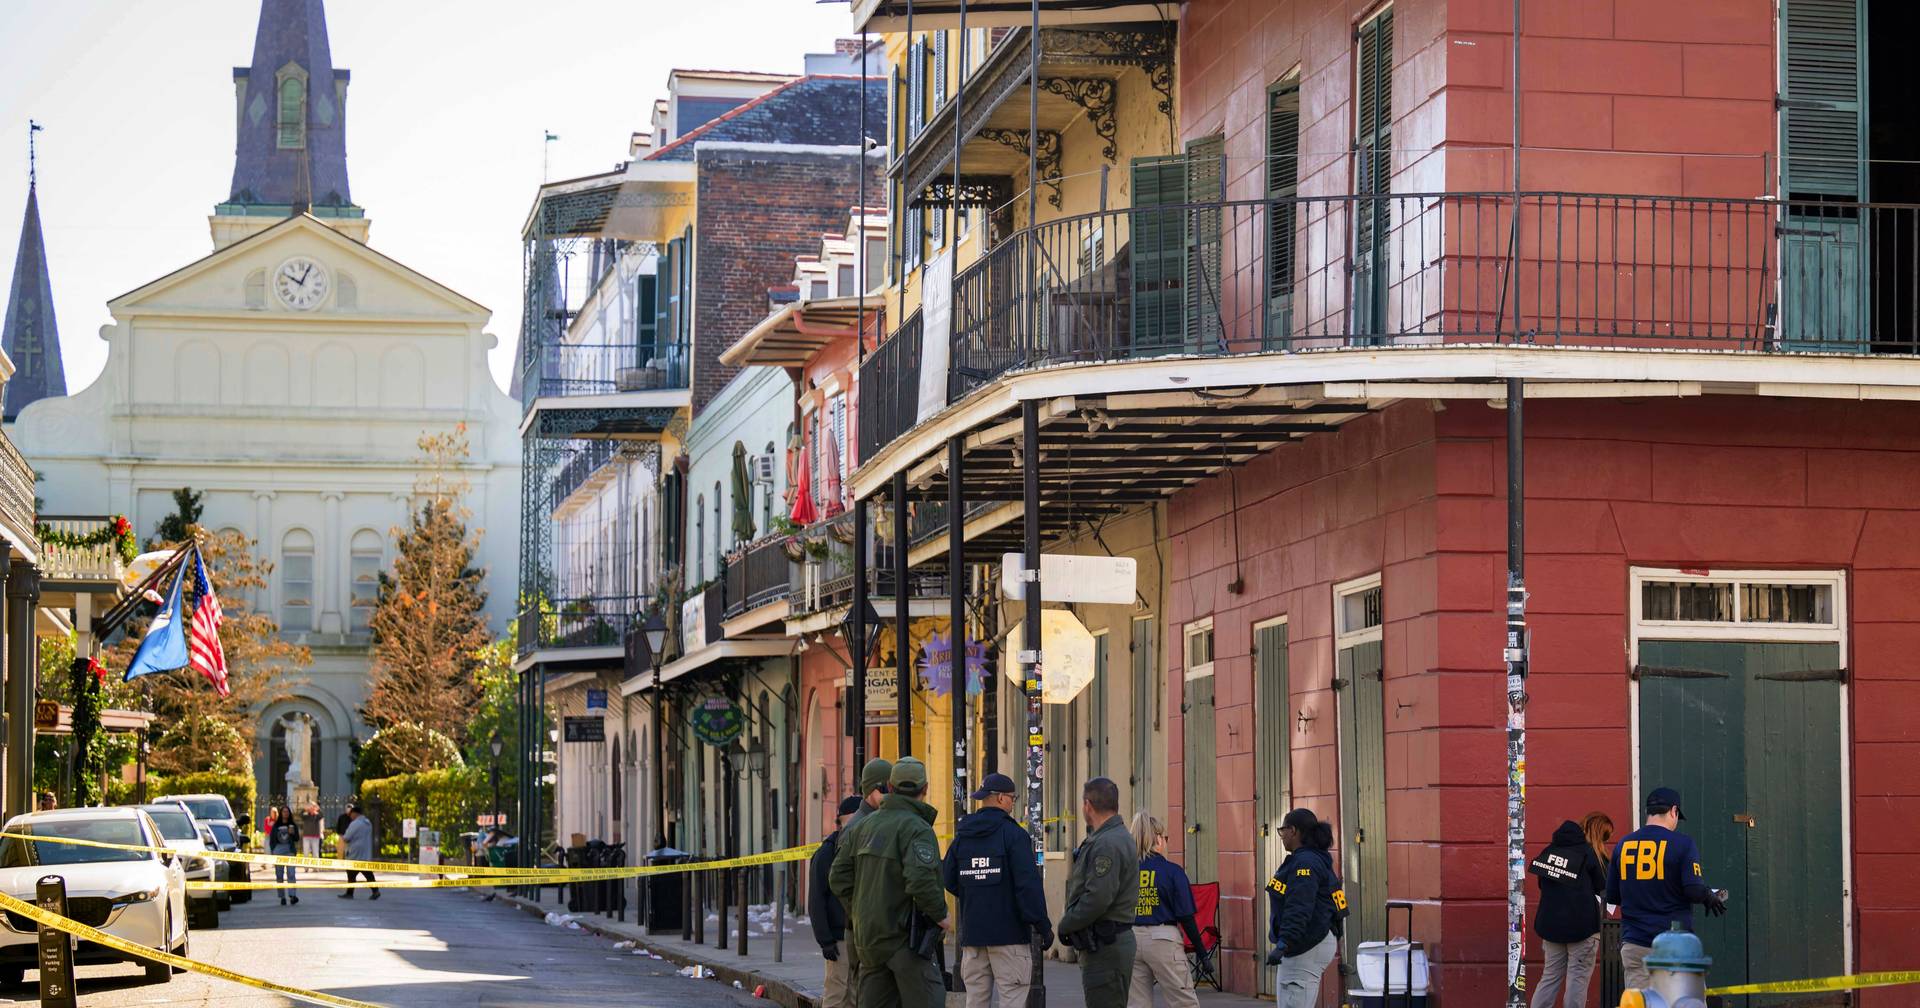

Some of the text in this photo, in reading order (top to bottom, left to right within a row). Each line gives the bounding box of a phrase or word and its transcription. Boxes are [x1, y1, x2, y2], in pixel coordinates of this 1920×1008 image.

[864, 678, 897, 687] IGAR
[972, 857, 989, 868] FBI
[1547, 854, 1568, 868] FBI
[1620, 840, 1667, 880] FBI
[1533, 860, 1578, 879] EVIDENCE RESPONSE
[1139, 870, 1156, 887] BI
[1268, 878, 1287, 894] FBI
[1138, 897, 1159, 906] PONSE
[1332, 890, 1348, 911] FB
[1135, 906, 1152, 916] TEAM
